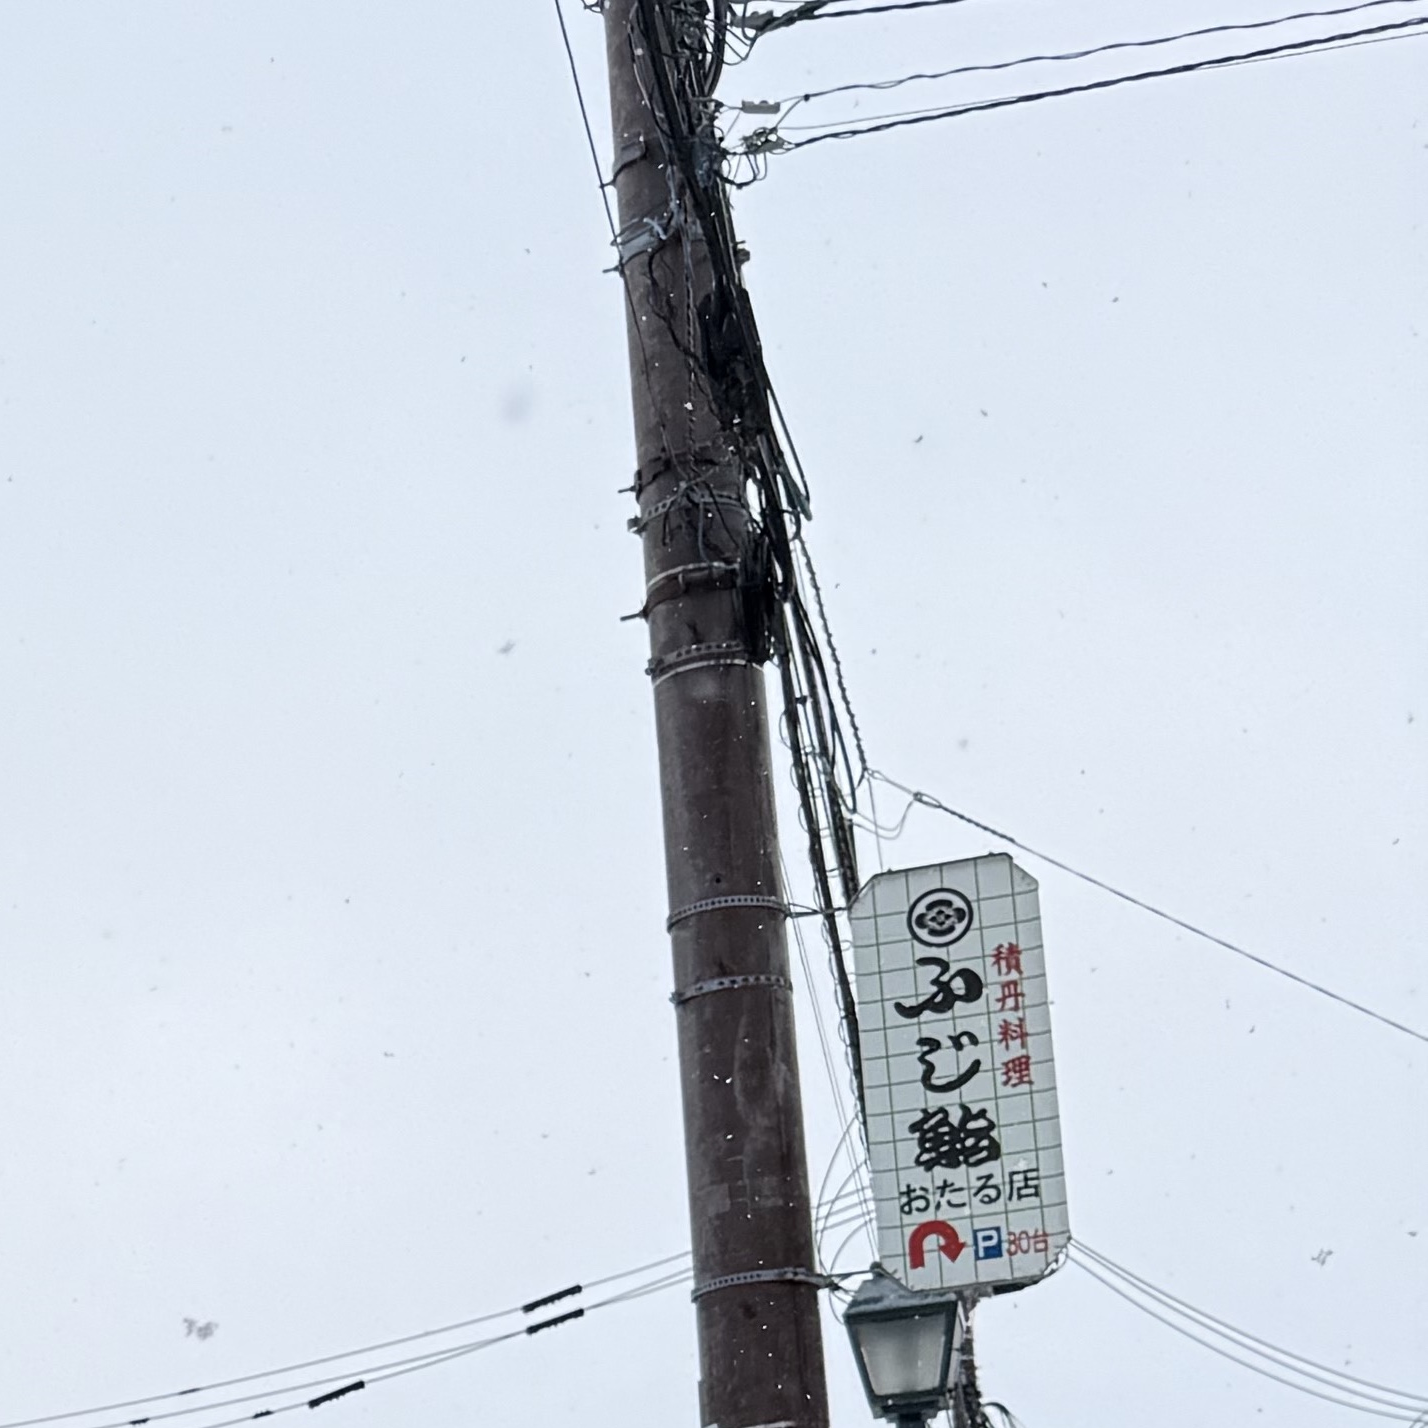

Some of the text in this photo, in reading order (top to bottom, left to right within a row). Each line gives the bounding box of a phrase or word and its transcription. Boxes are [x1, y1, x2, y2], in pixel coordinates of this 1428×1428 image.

[990, 942, 1034, 1089] 積丹料理
[900, 1168, 1040, 1216] おたる店
